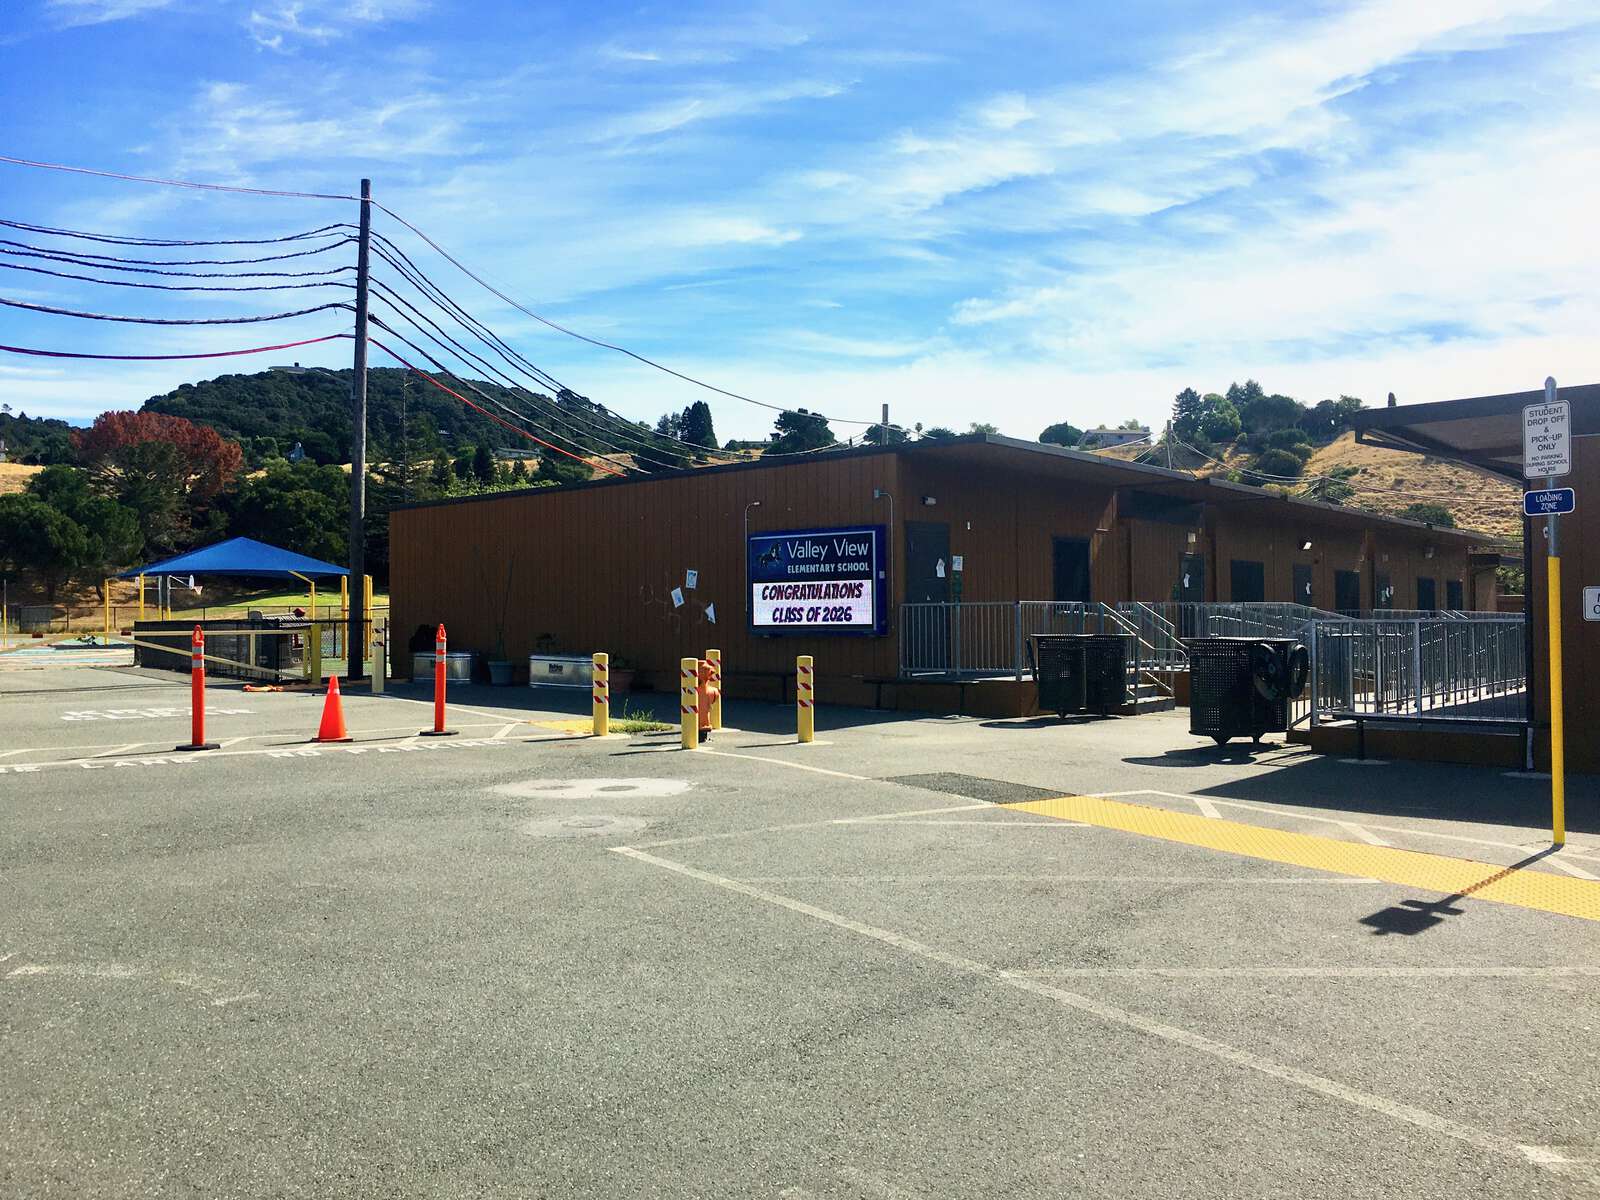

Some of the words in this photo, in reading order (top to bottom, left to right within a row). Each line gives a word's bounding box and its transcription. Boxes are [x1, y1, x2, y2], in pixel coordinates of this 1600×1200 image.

[1529, 406, 1563, 418] STUDENT
[1527, 418, 1549, 427] DROP
[1550, 415, 1566, 424] OFF
[1531, 433, 1563, 444] PICK-UP
[1537, 442, 1557, 452] ONLY
[1547, 458, 1568, 466] SCHOOL
[1535, 493, 1562, 503] LOADING
[1541, 502, 1558, 511] ZONE
[787, 540, 828, 561] Valley
[833, 538, 869, 557] View
[787, 563, 835, 574] ELEMENTARY
[837, 562, 870, 572] SCHOOL
[762, 582, 864, 601] CONGRATULATIONS
[772, 606, 804, 623] CLASS
[806, 606, 822, 622] OF
[822, 606, 852, 622] 2026
[79, 758, 199, 769] LANE
[267, 750, 323, 758] NO
[345, 740, 508, 754] PARKING
